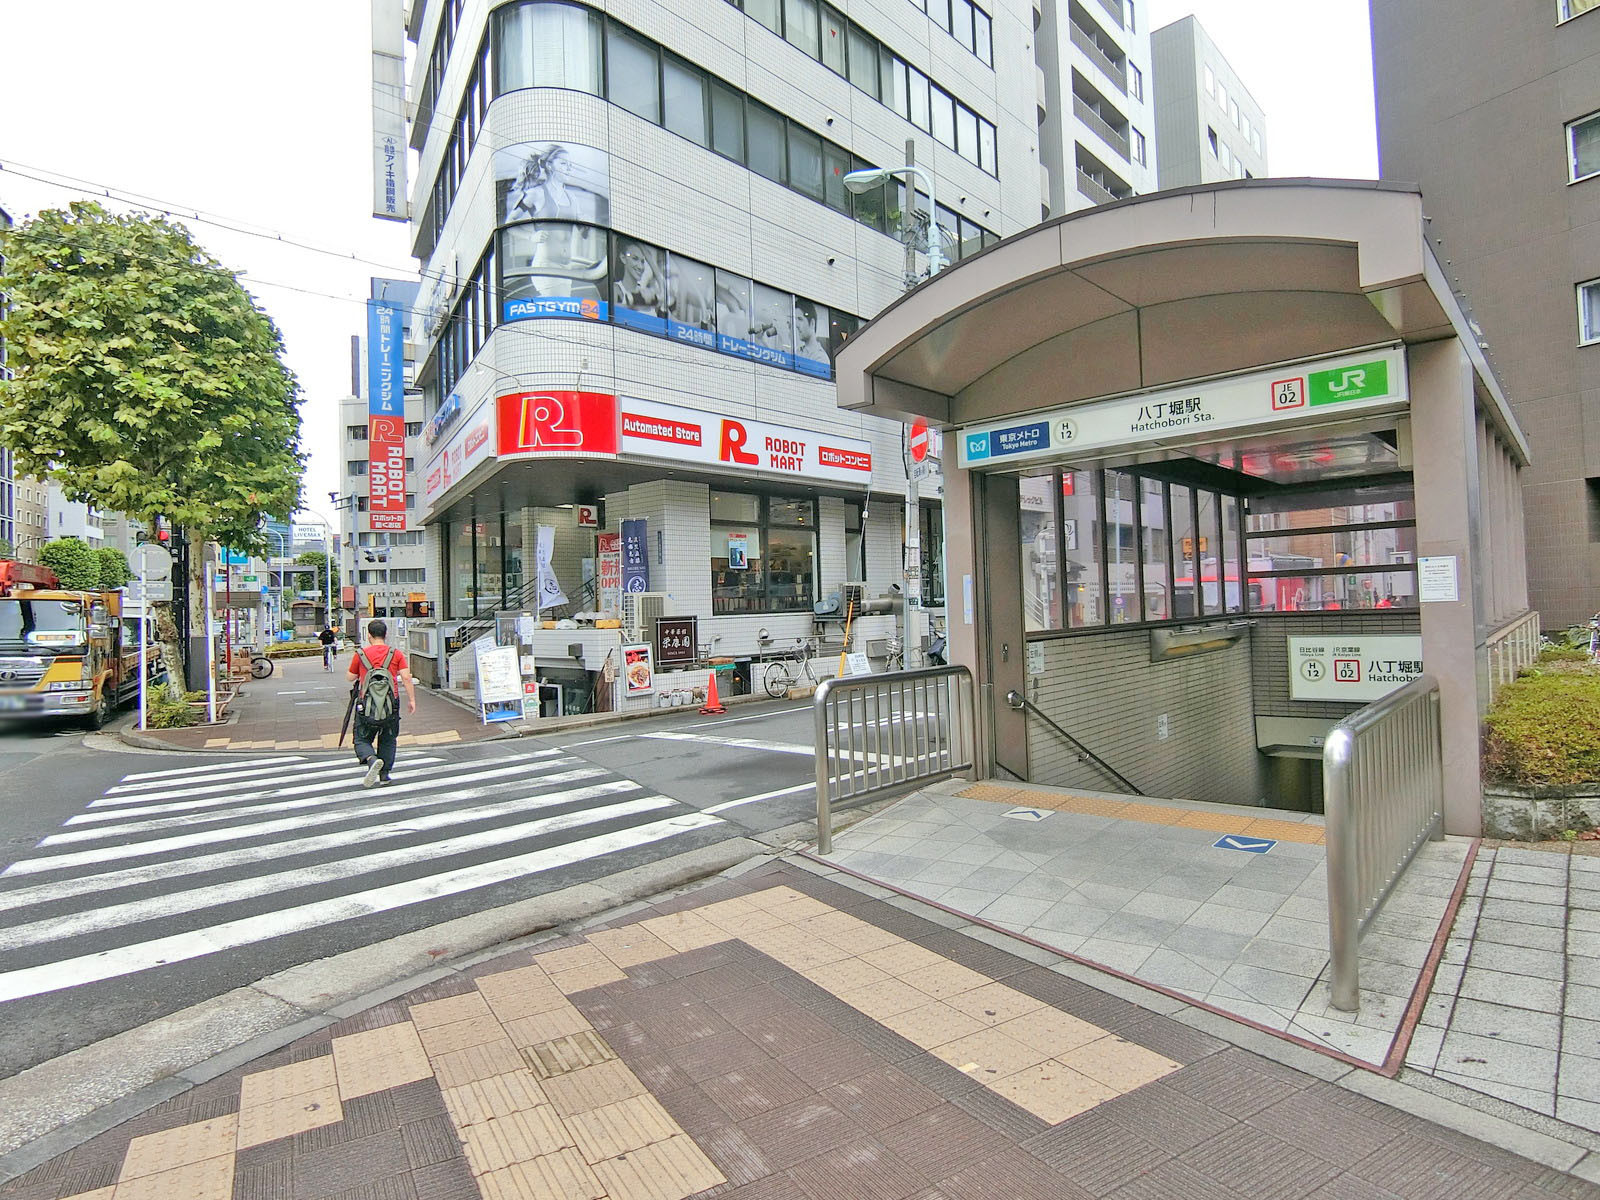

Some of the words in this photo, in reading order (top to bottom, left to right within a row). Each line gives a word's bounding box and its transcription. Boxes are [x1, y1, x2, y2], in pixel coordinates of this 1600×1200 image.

[1282, 383, 1293, 392] JE
[1328, 369, 1366, 392] JR
[1280, 391, 1296, 404] 02
[1138, 397, 1201, 421] 八丁堀駅
[624, 418, 673, 438] Automated
[676, 426, 700, 441] Store
[1131, 415, 1190, 432] Hatchobori
[1194, 413, 1215, 422] Sta.
[1000, 428, 1040, 443] 東京メトロ
[1061, 430, 1072, 439] 12
[765, 436, 806, 457] ROBOT
[1002, 441, 1019, 450] Tokyo
[1020, 439, 1038, 448] Metro
[770, 453, 804, 472] MART
[822, 451, 869, 467] ロボットコンビニ
[388, 446, 404, 503] ROBOT
[372, 461, 388, 508] MART
[1340, 670, 1354, 678] 02
